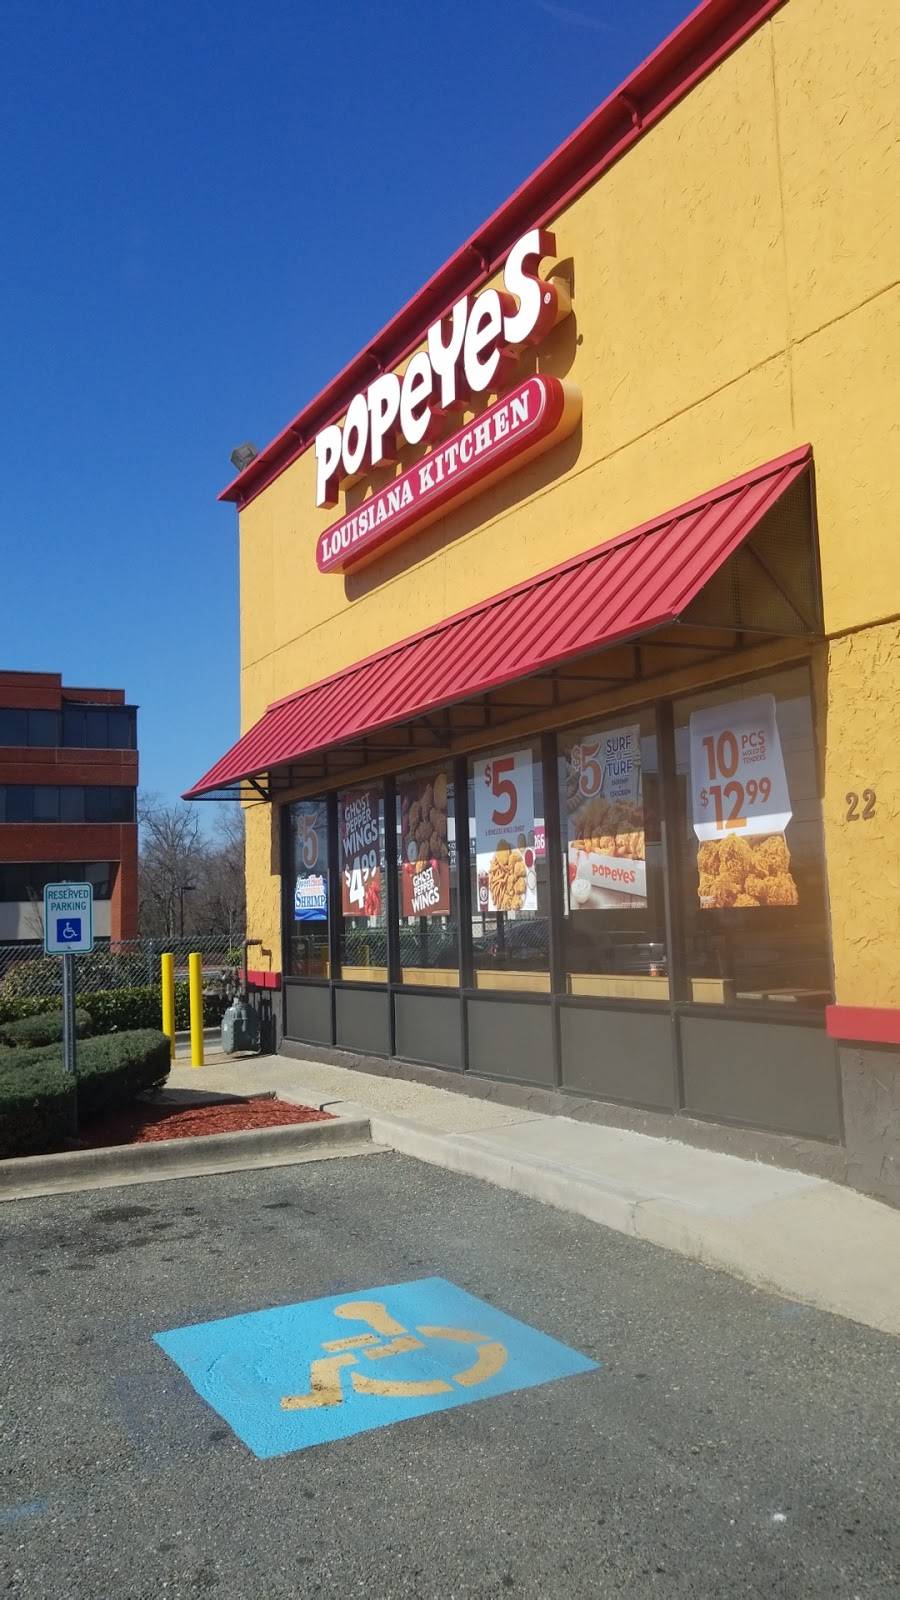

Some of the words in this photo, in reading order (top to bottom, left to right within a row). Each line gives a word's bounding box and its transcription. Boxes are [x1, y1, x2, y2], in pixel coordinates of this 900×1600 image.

[321, 483, 414, 563] LOUISIANA
[418, 390, 531, 488] KITCHEN
[606, 735, 632, 753] SURF
[702, 730, 739, 780] 10
[742, 731, 765, 748] PCS
[606, 760, 632, 776] TURF
[484, 758, 518, 826] $5
[845, 788, 876, 823] 22
[345, 793, 370, 820] GHOST
[346, 808, 372, 837] PEPPER
[343, 820, 378, 858] WINGS
[412, 867, 433, 887] GHOST
[413, 879, 434, 897] PEPPER
[48, 889, 89, 900] RESERVED
[50, 901, 87, 911] PARKING
[295, 891, 327, 908] SHRIMP
[411, 886, 440, 913] WINGS
